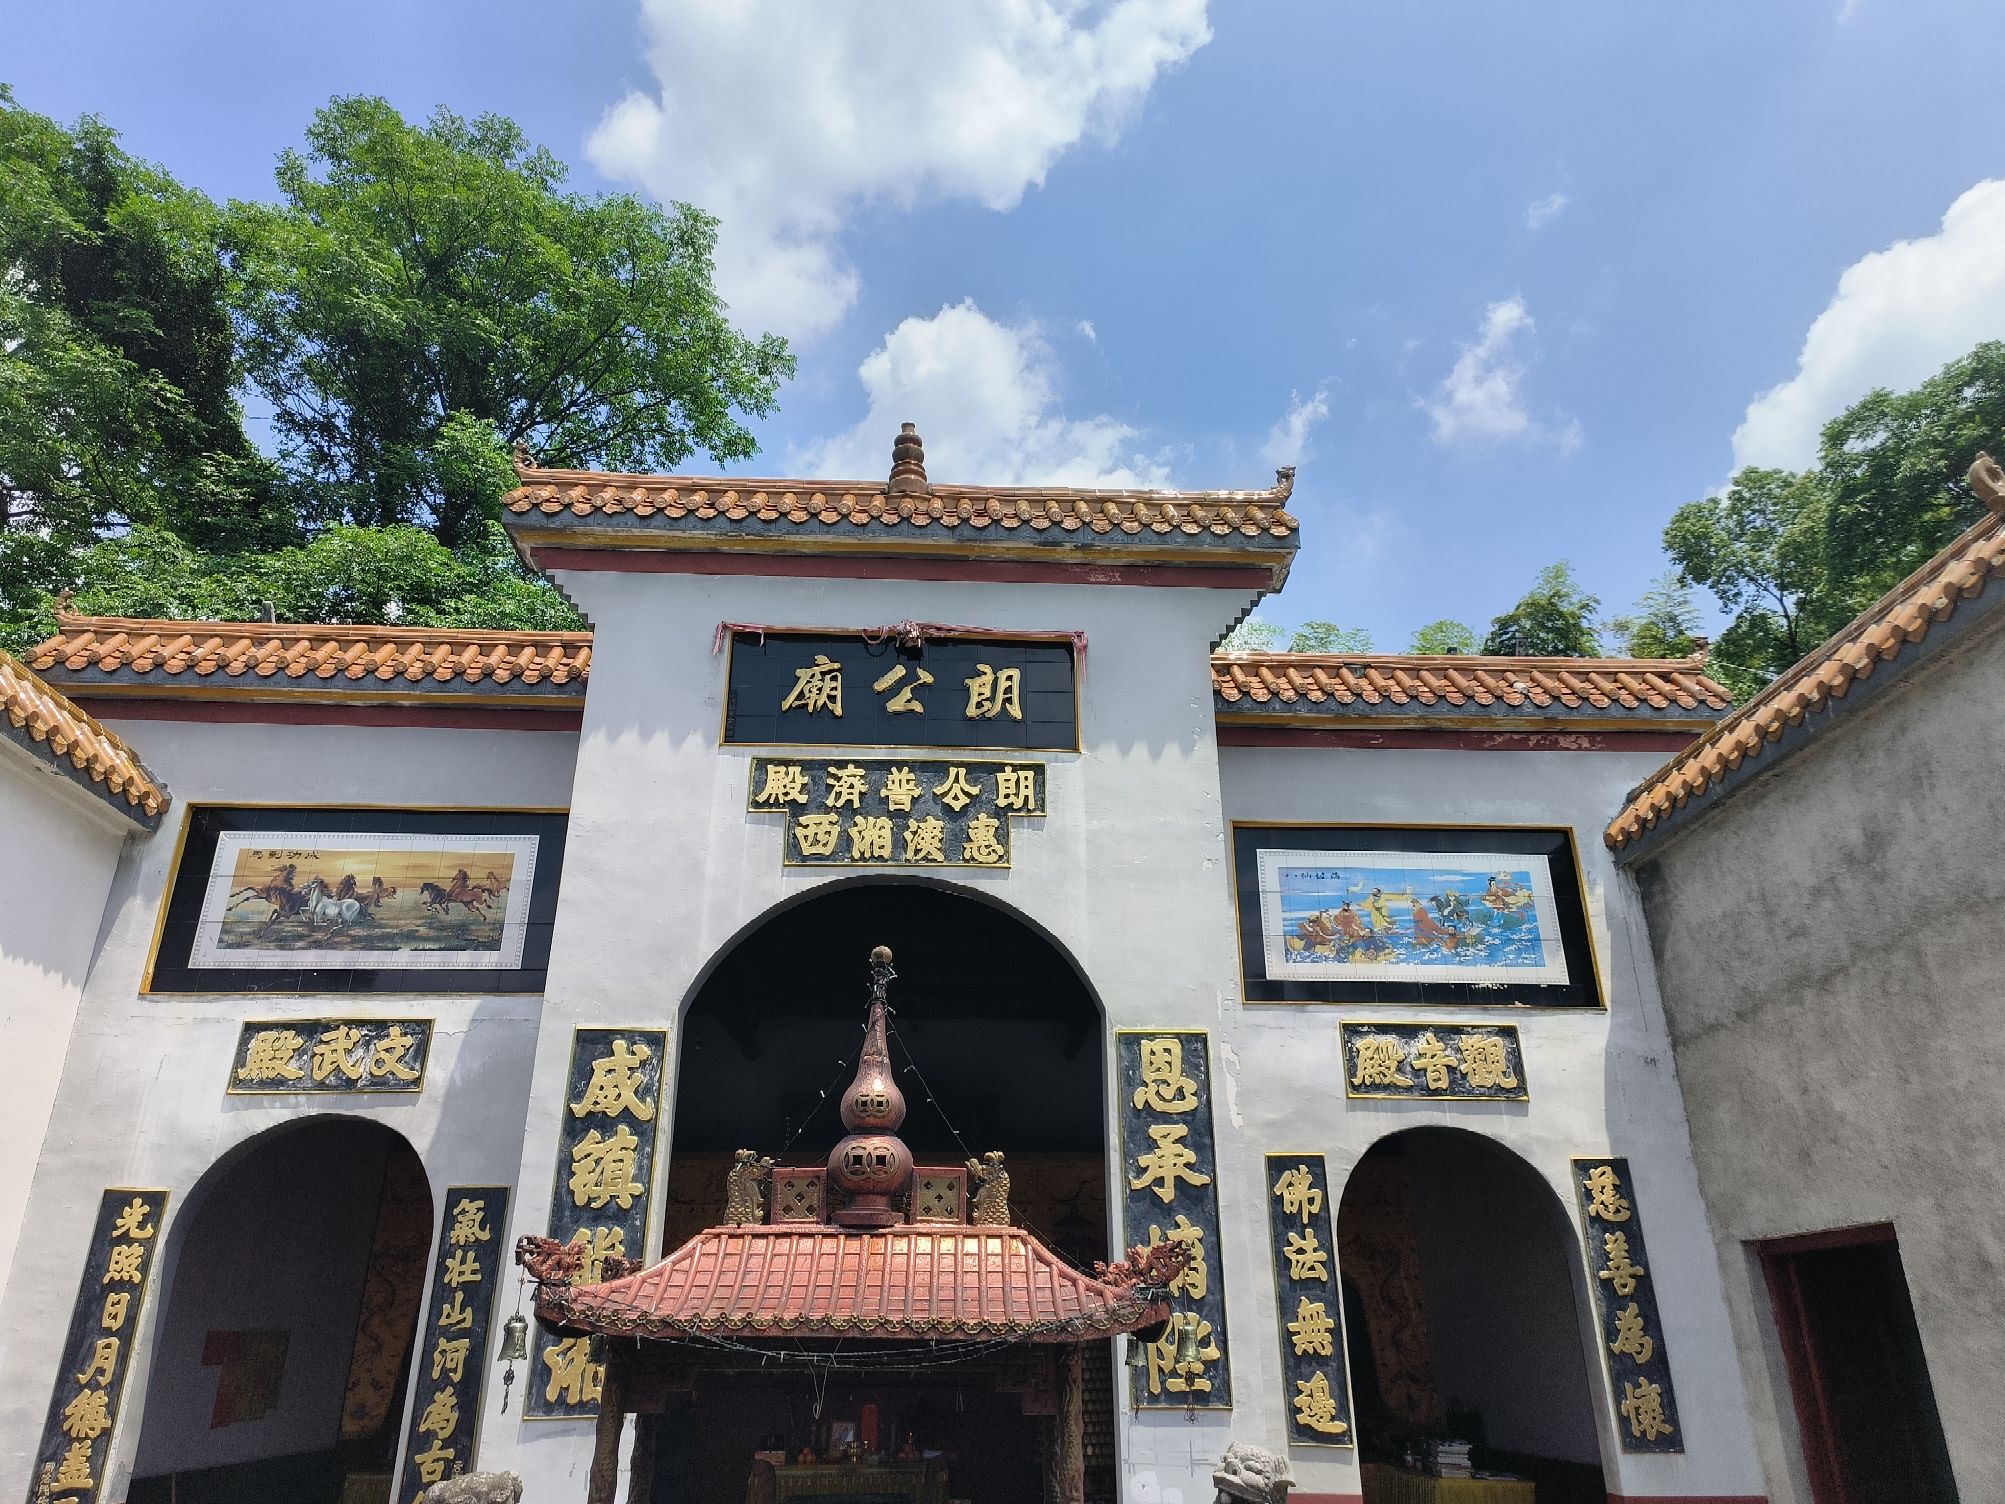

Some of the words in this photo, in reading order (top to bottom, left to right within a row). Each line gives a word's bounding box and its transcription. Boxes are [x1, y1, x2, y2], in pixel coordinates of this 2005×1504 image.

[780, 655, 1023, 721] 朗公廟
[755, 765, 1036, 812] 朗公普濟殿
[237, 1024, 419, 1081] 文武殿
[1351, 1033, 1519, 1090] 觀音殿
[1273, 1164, 1348, 1434] 佛法無邊
